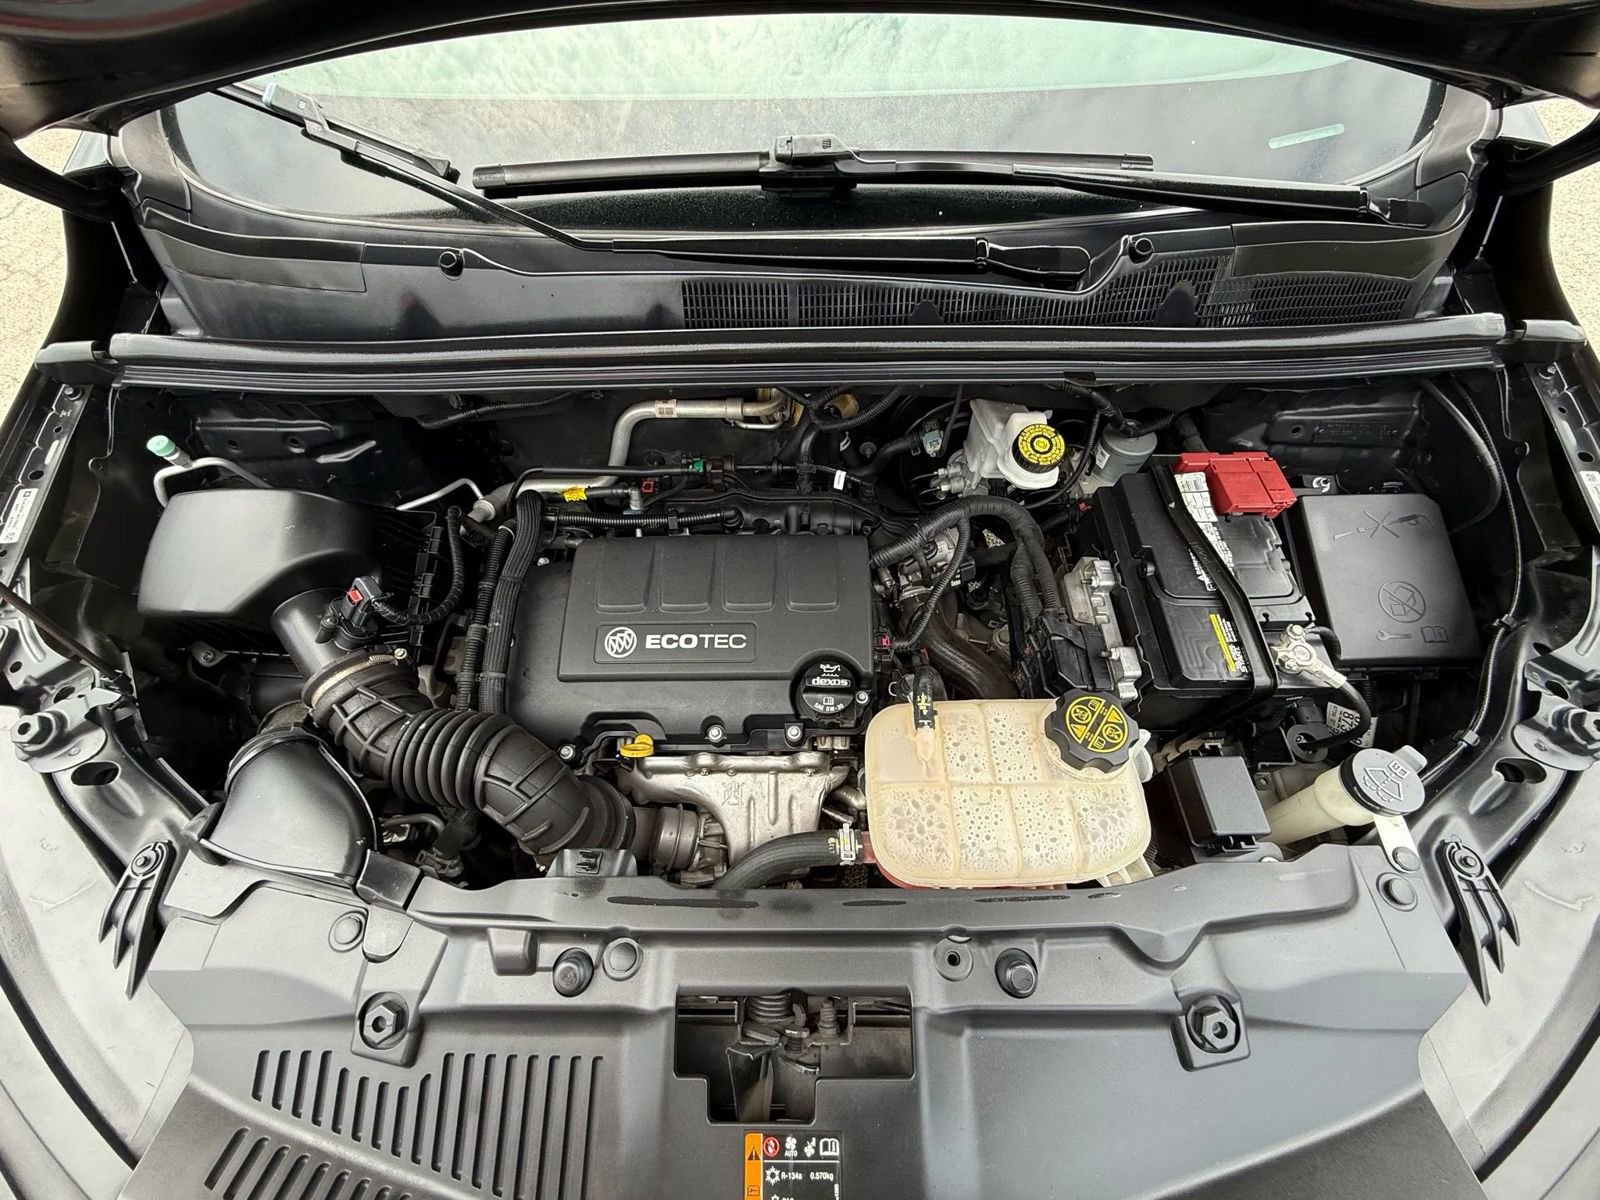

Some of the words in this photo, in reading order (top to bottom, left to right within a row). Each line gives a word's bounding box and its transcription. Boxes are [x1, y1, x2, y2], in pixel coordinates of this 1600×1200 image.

[645, 634, 747, 649] ECOTEC
[811, 676, 848, 686] dexos
[781, 1171, 803, 1180] R-134a
[810, 1171, 834, 1181] 0.570kg
